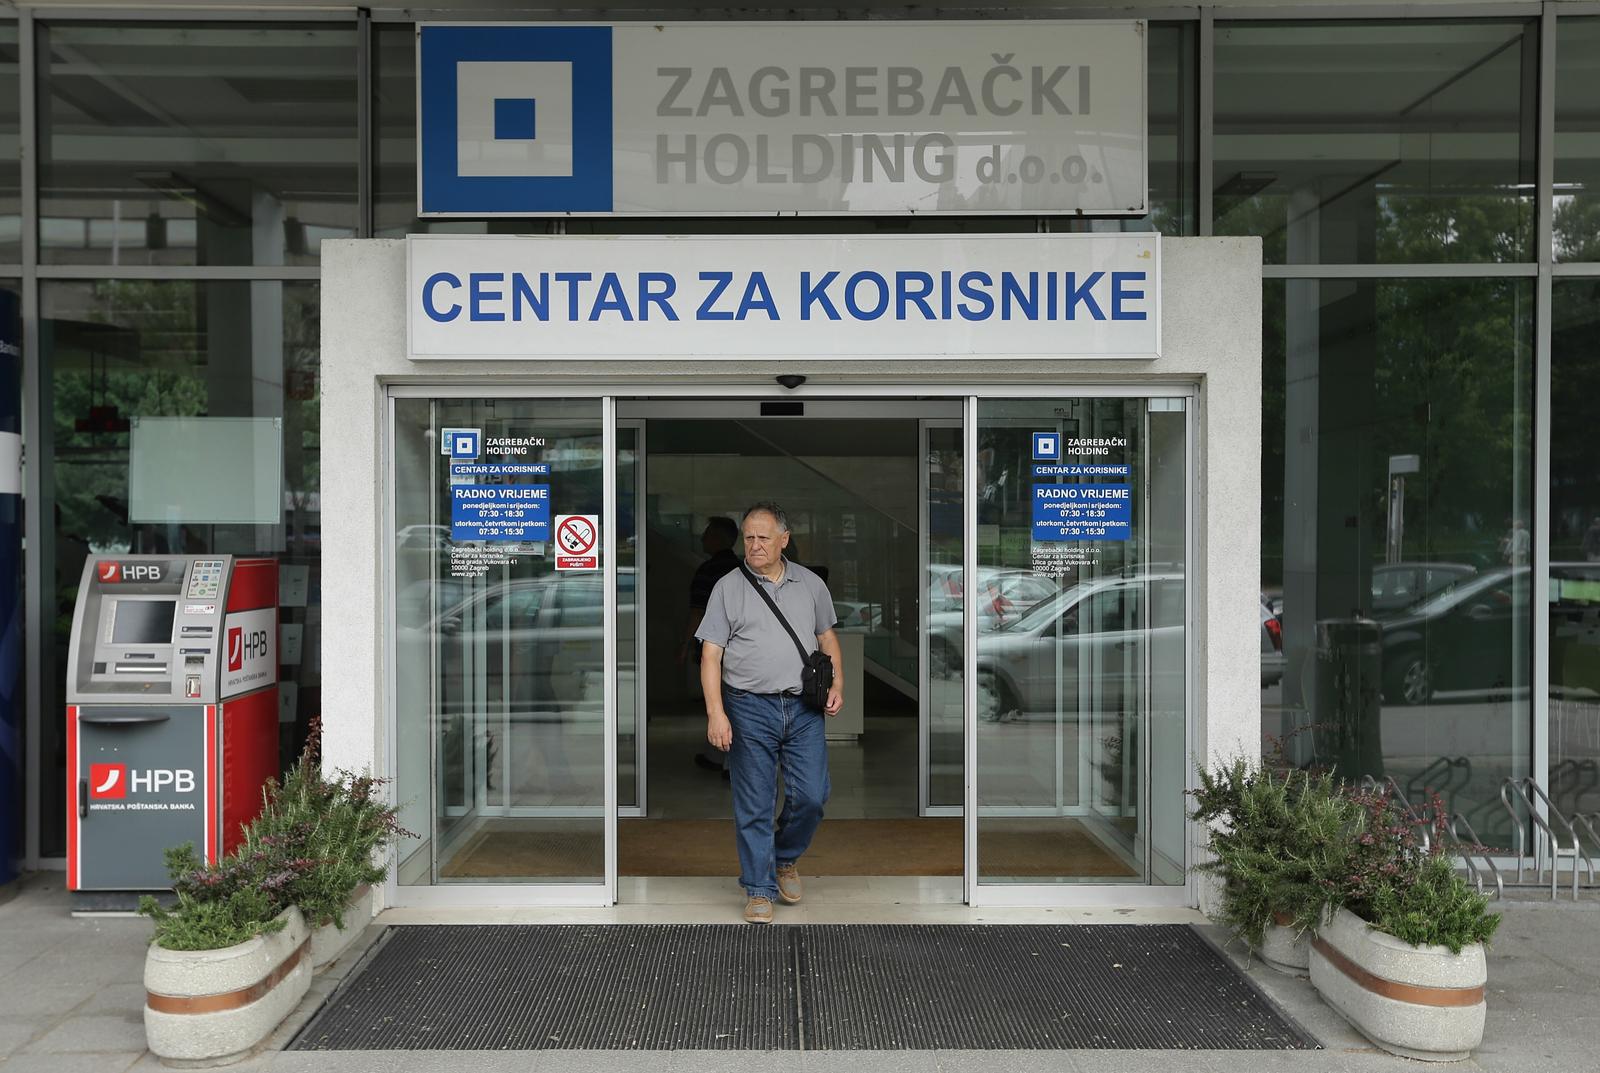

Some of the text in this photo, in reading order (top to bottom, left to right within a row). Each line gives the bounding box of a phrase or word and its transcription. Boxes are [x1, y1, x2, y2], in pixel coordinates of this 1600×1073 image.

[656, 53, 1091, 118] ZAGREBAČKI
[656, 133, 1104, 185] HOLDING d.o.o.
[422, 270, 1147, 323] CENTAR ZA KORISNIKE
[486, 437, 545, 446] ZAGREBAČKI
[1068, 437, 1127, 446] ZAGREBAČKI
[486, 447, 527, 455] HOLDING
[1068, 447, 1109, 455] HOLDING
[455, 489, 547, 499] RADNO VRIJEME
[1037, 489, 1129, 499] RADNO VRIJEME
[462, 502, 506, 510] ponedjeljkom
[509, 502, 540, 510] srijedom:
[122, 565, 161, 580] HPB
[244, 630, 268, 660] HPB
[131, 769, 196, 792] HPB
[127, 802, 168, 810] POŠTANSKA
